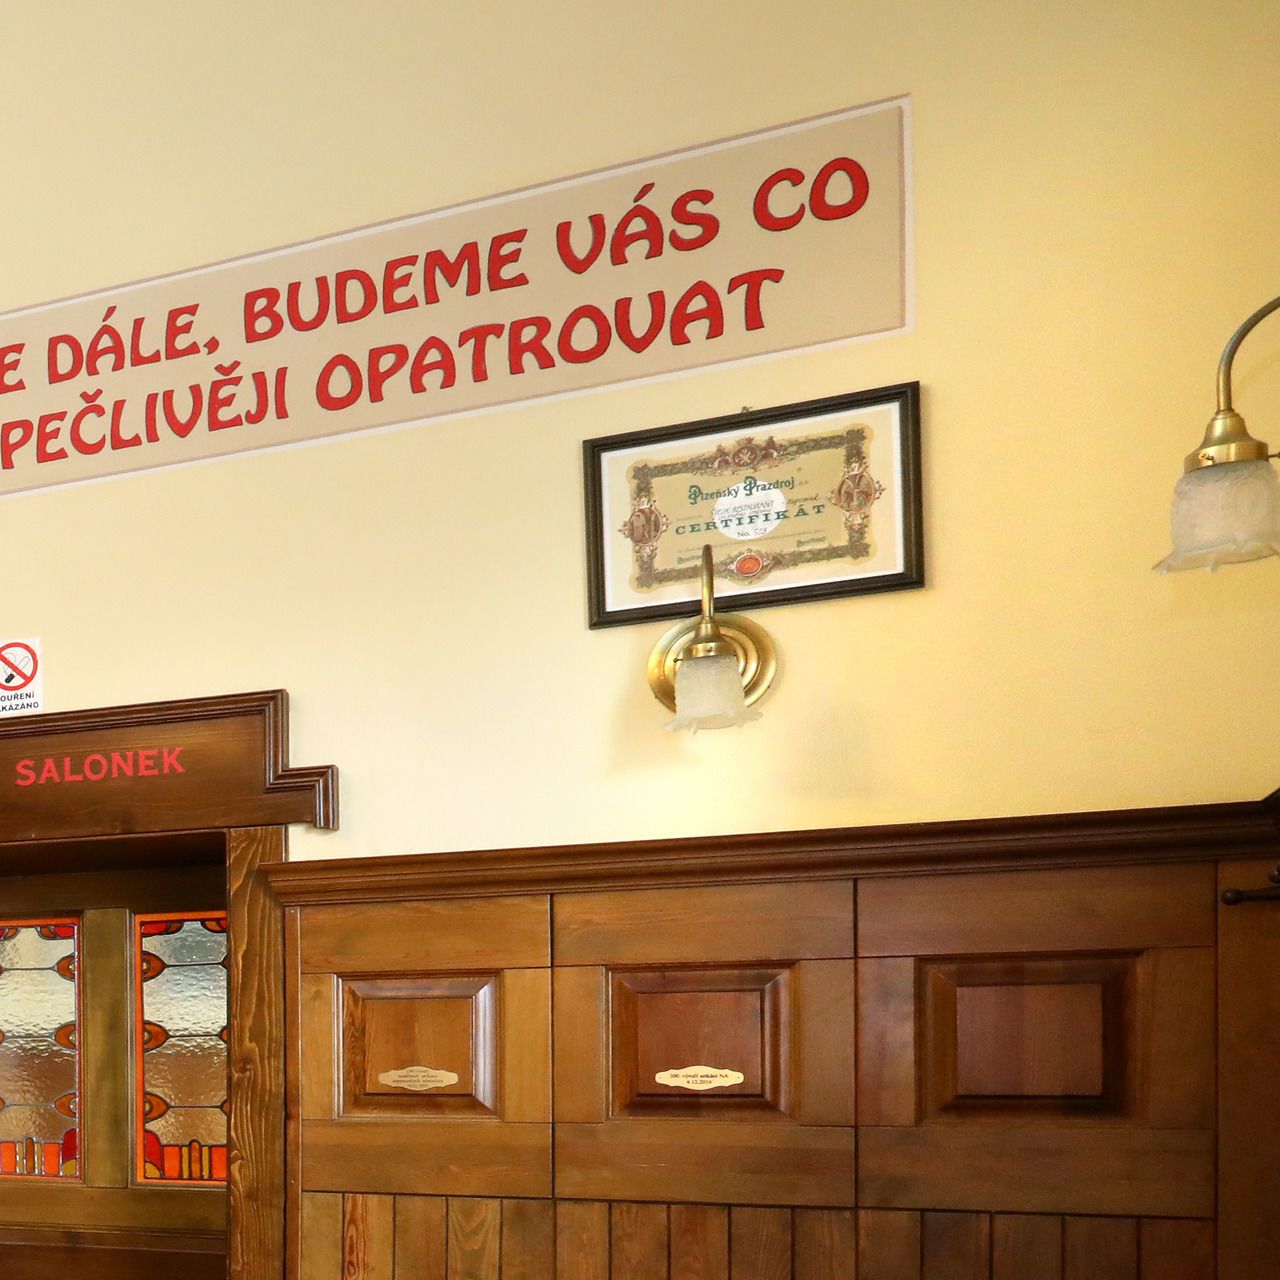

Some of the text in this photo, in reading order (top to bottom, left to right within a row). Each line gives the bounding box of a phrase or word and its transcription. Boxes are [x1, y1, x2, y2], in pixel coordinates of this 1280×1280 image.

[47, 304, 221, 385] DÁLE,
[243, 228, 529, 344] BUDEME
[556, 182, 721, 275] VÁS
[753, 157, 871, 232] CO
[315, 268, 785, 412] OPATROVAT
[688, 476, 796, 505] Plzeňský Prazdroj
[675, 503, 826, 536] CERTIFIKÁT
[15, 747, 185, 787] SALONEK
